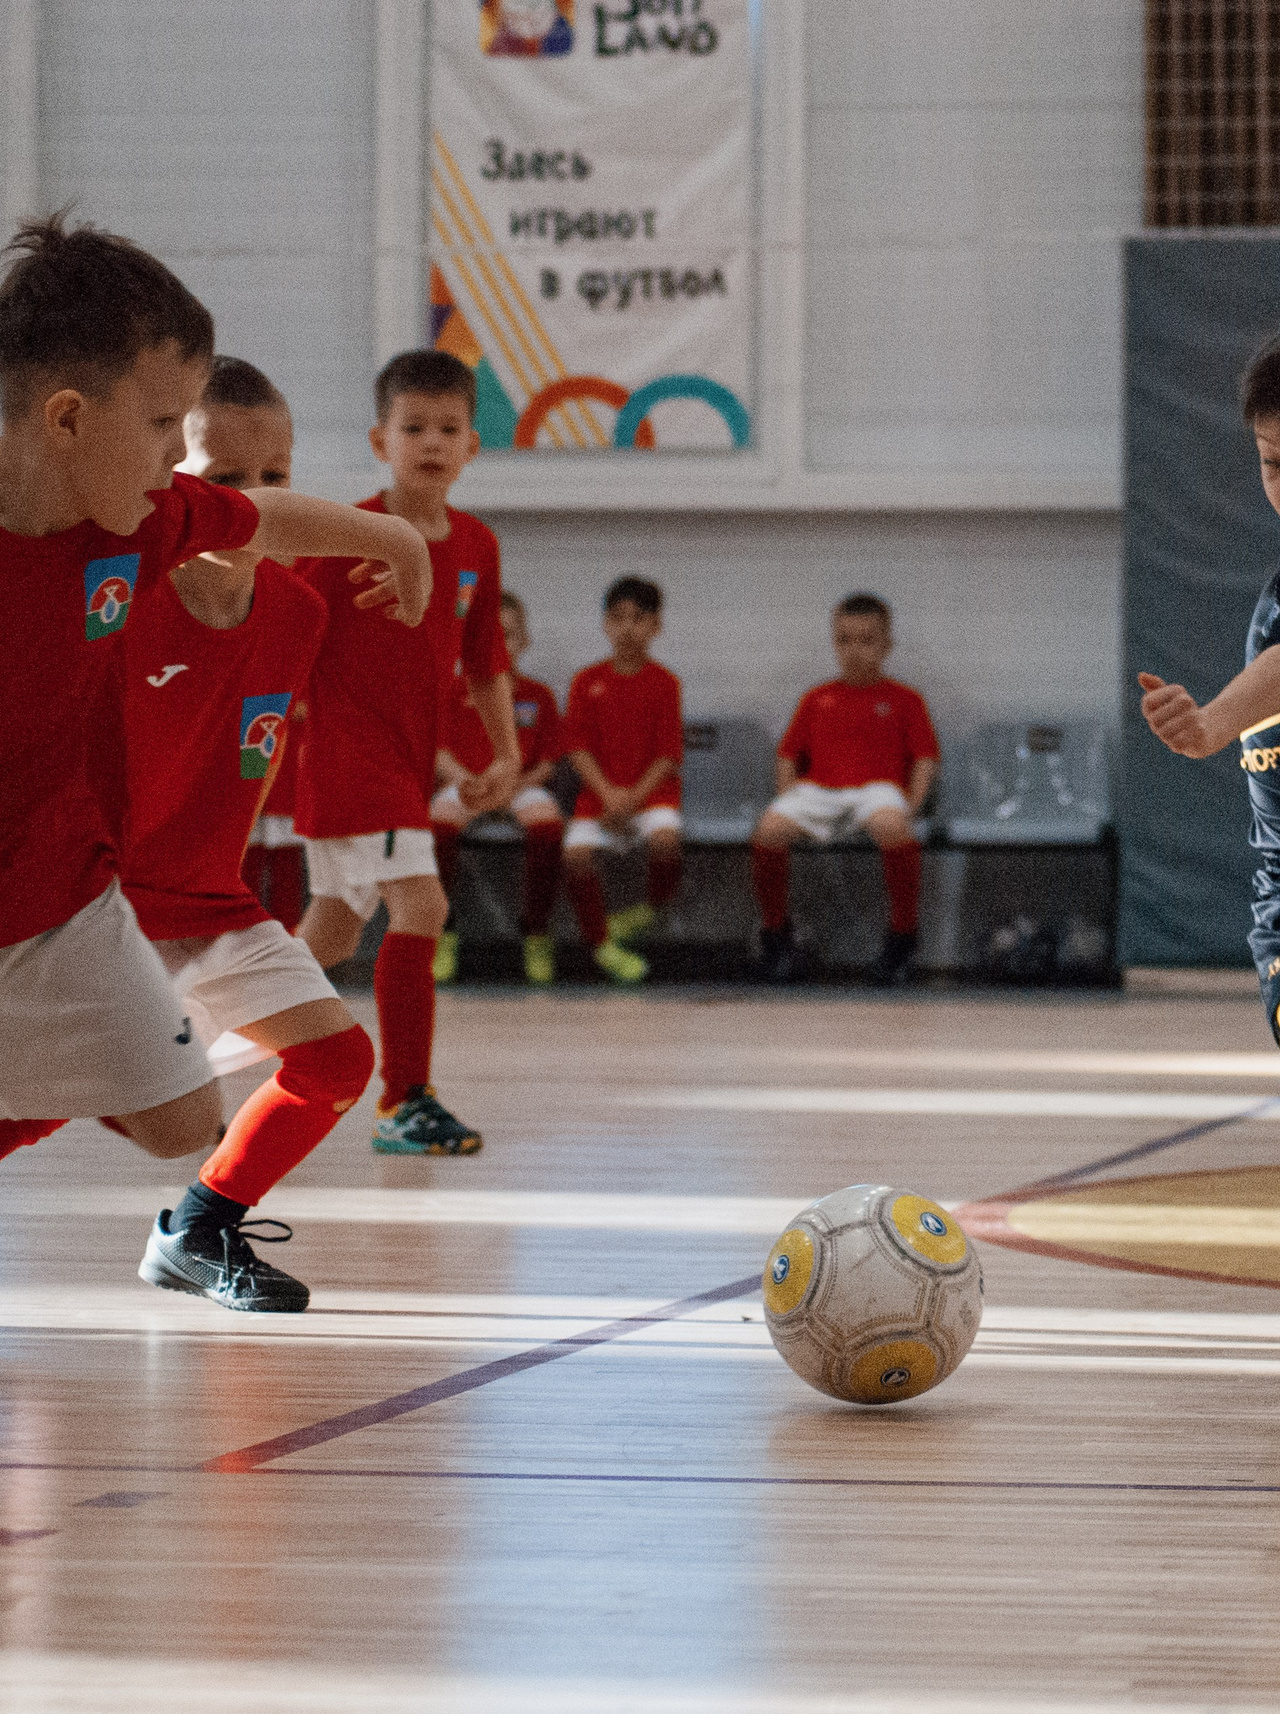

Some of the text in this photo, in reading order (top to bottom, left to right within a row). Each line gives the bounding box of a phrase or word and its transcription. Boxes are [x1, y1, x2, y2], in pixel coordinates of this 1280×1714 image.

[480, 137, 592, 182] Здесь
[509, 207, 656, 244] играют
[576, 266, 727, 312] футбол
